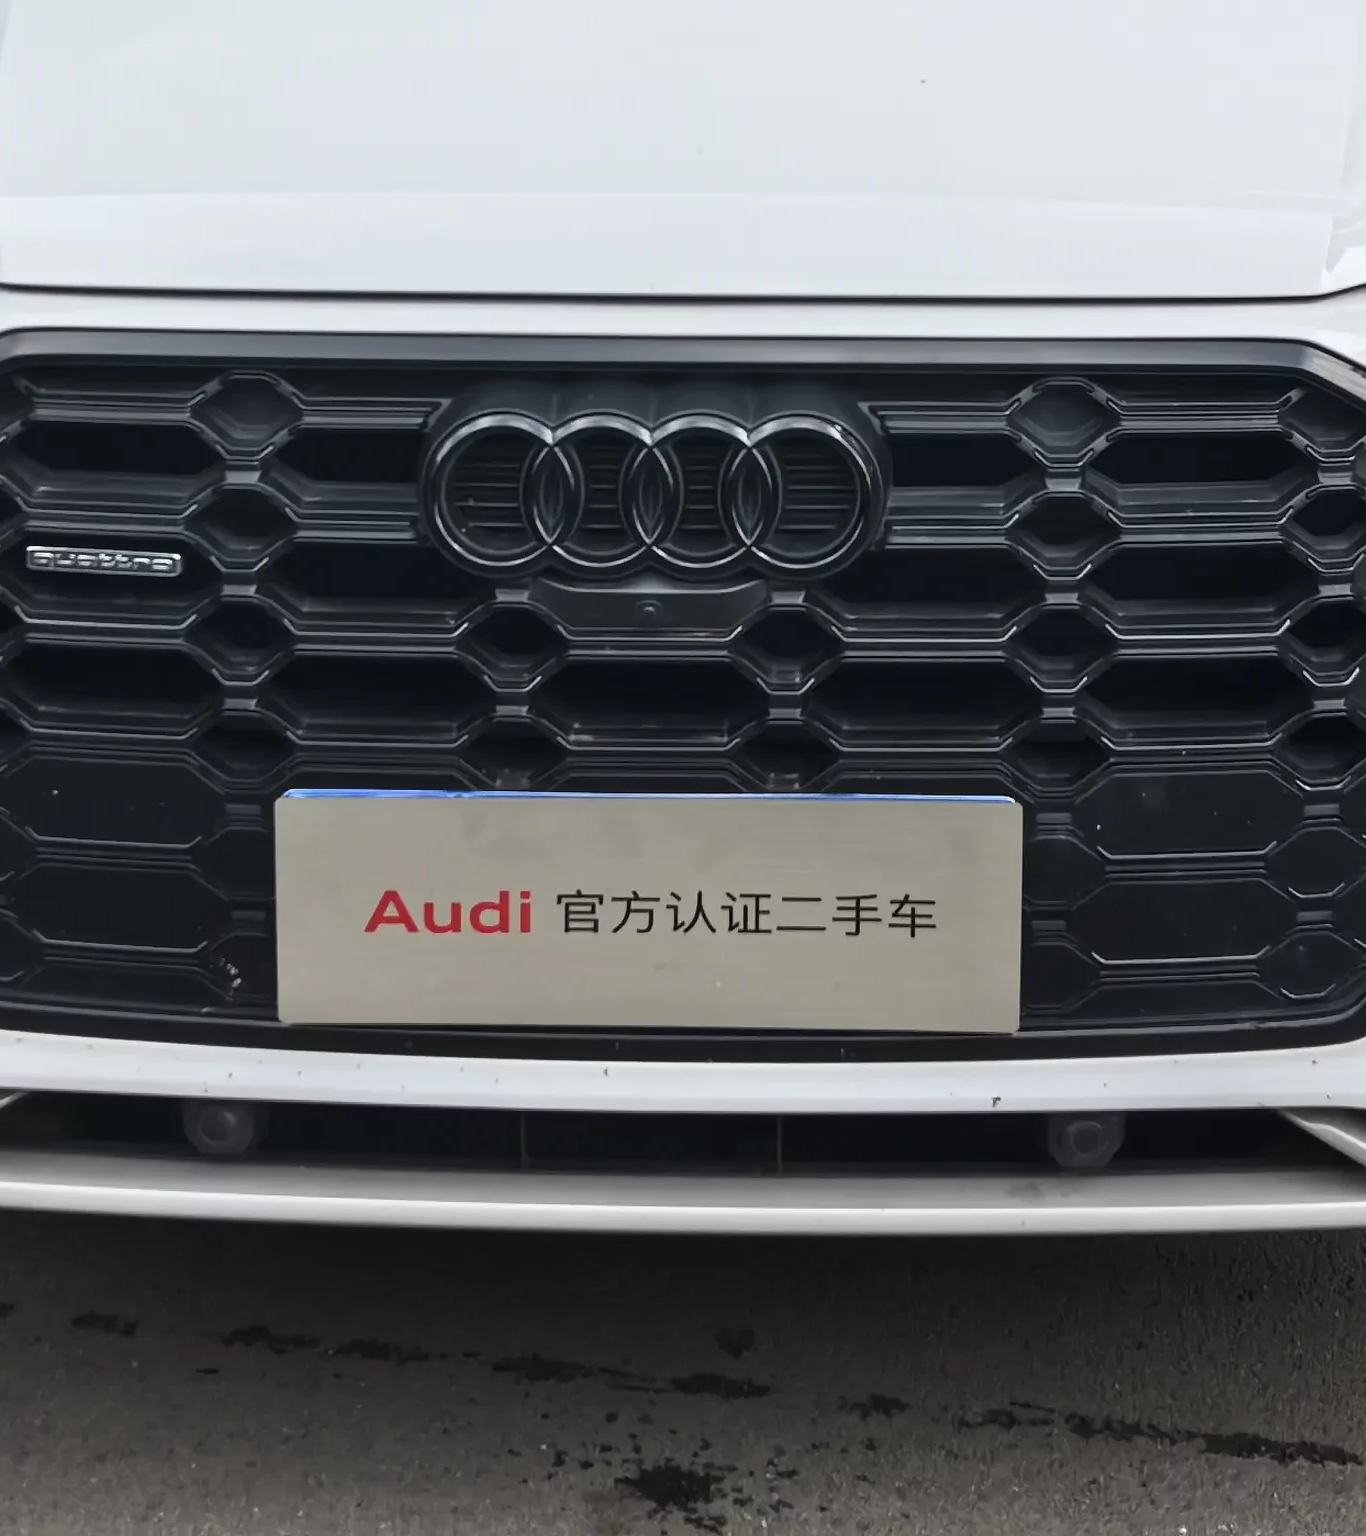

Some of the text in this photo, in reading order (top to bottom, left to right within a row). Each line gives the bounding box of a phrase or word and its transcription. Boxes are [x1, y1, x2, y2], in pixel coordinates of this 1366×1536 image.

[31, 550, 175, 572] quattro
[364, 888, 937, 939] Audi 官方认证二手车
